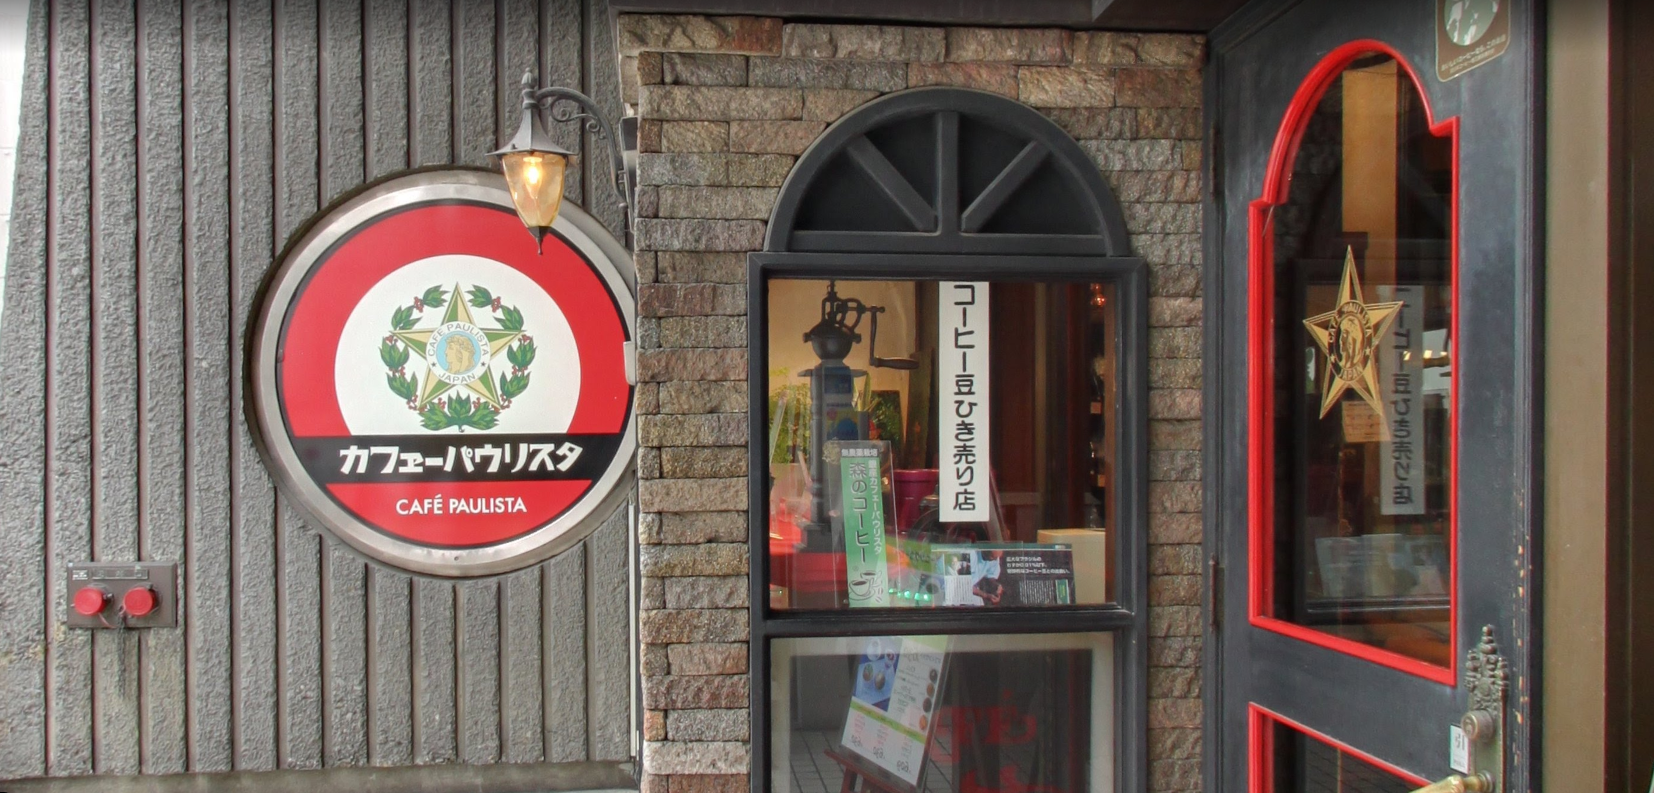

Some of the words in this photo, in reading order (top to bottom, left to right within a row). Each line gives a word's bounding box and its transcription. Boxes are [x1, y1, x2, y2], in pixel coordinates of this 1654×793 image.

[427, 329, 447, 357] CAFE
[446, 322, 490, 357] PAULISTA
[438, 372, 477, 383] JAPAN
[953, 284, 978, 511] コーヒー豆ひき売り店
[395, 494, 442, 515] CAFÉ
[449, 496, 527, 514] PAULISTA
[849, 461, 870, 563] 森のコーヒー
